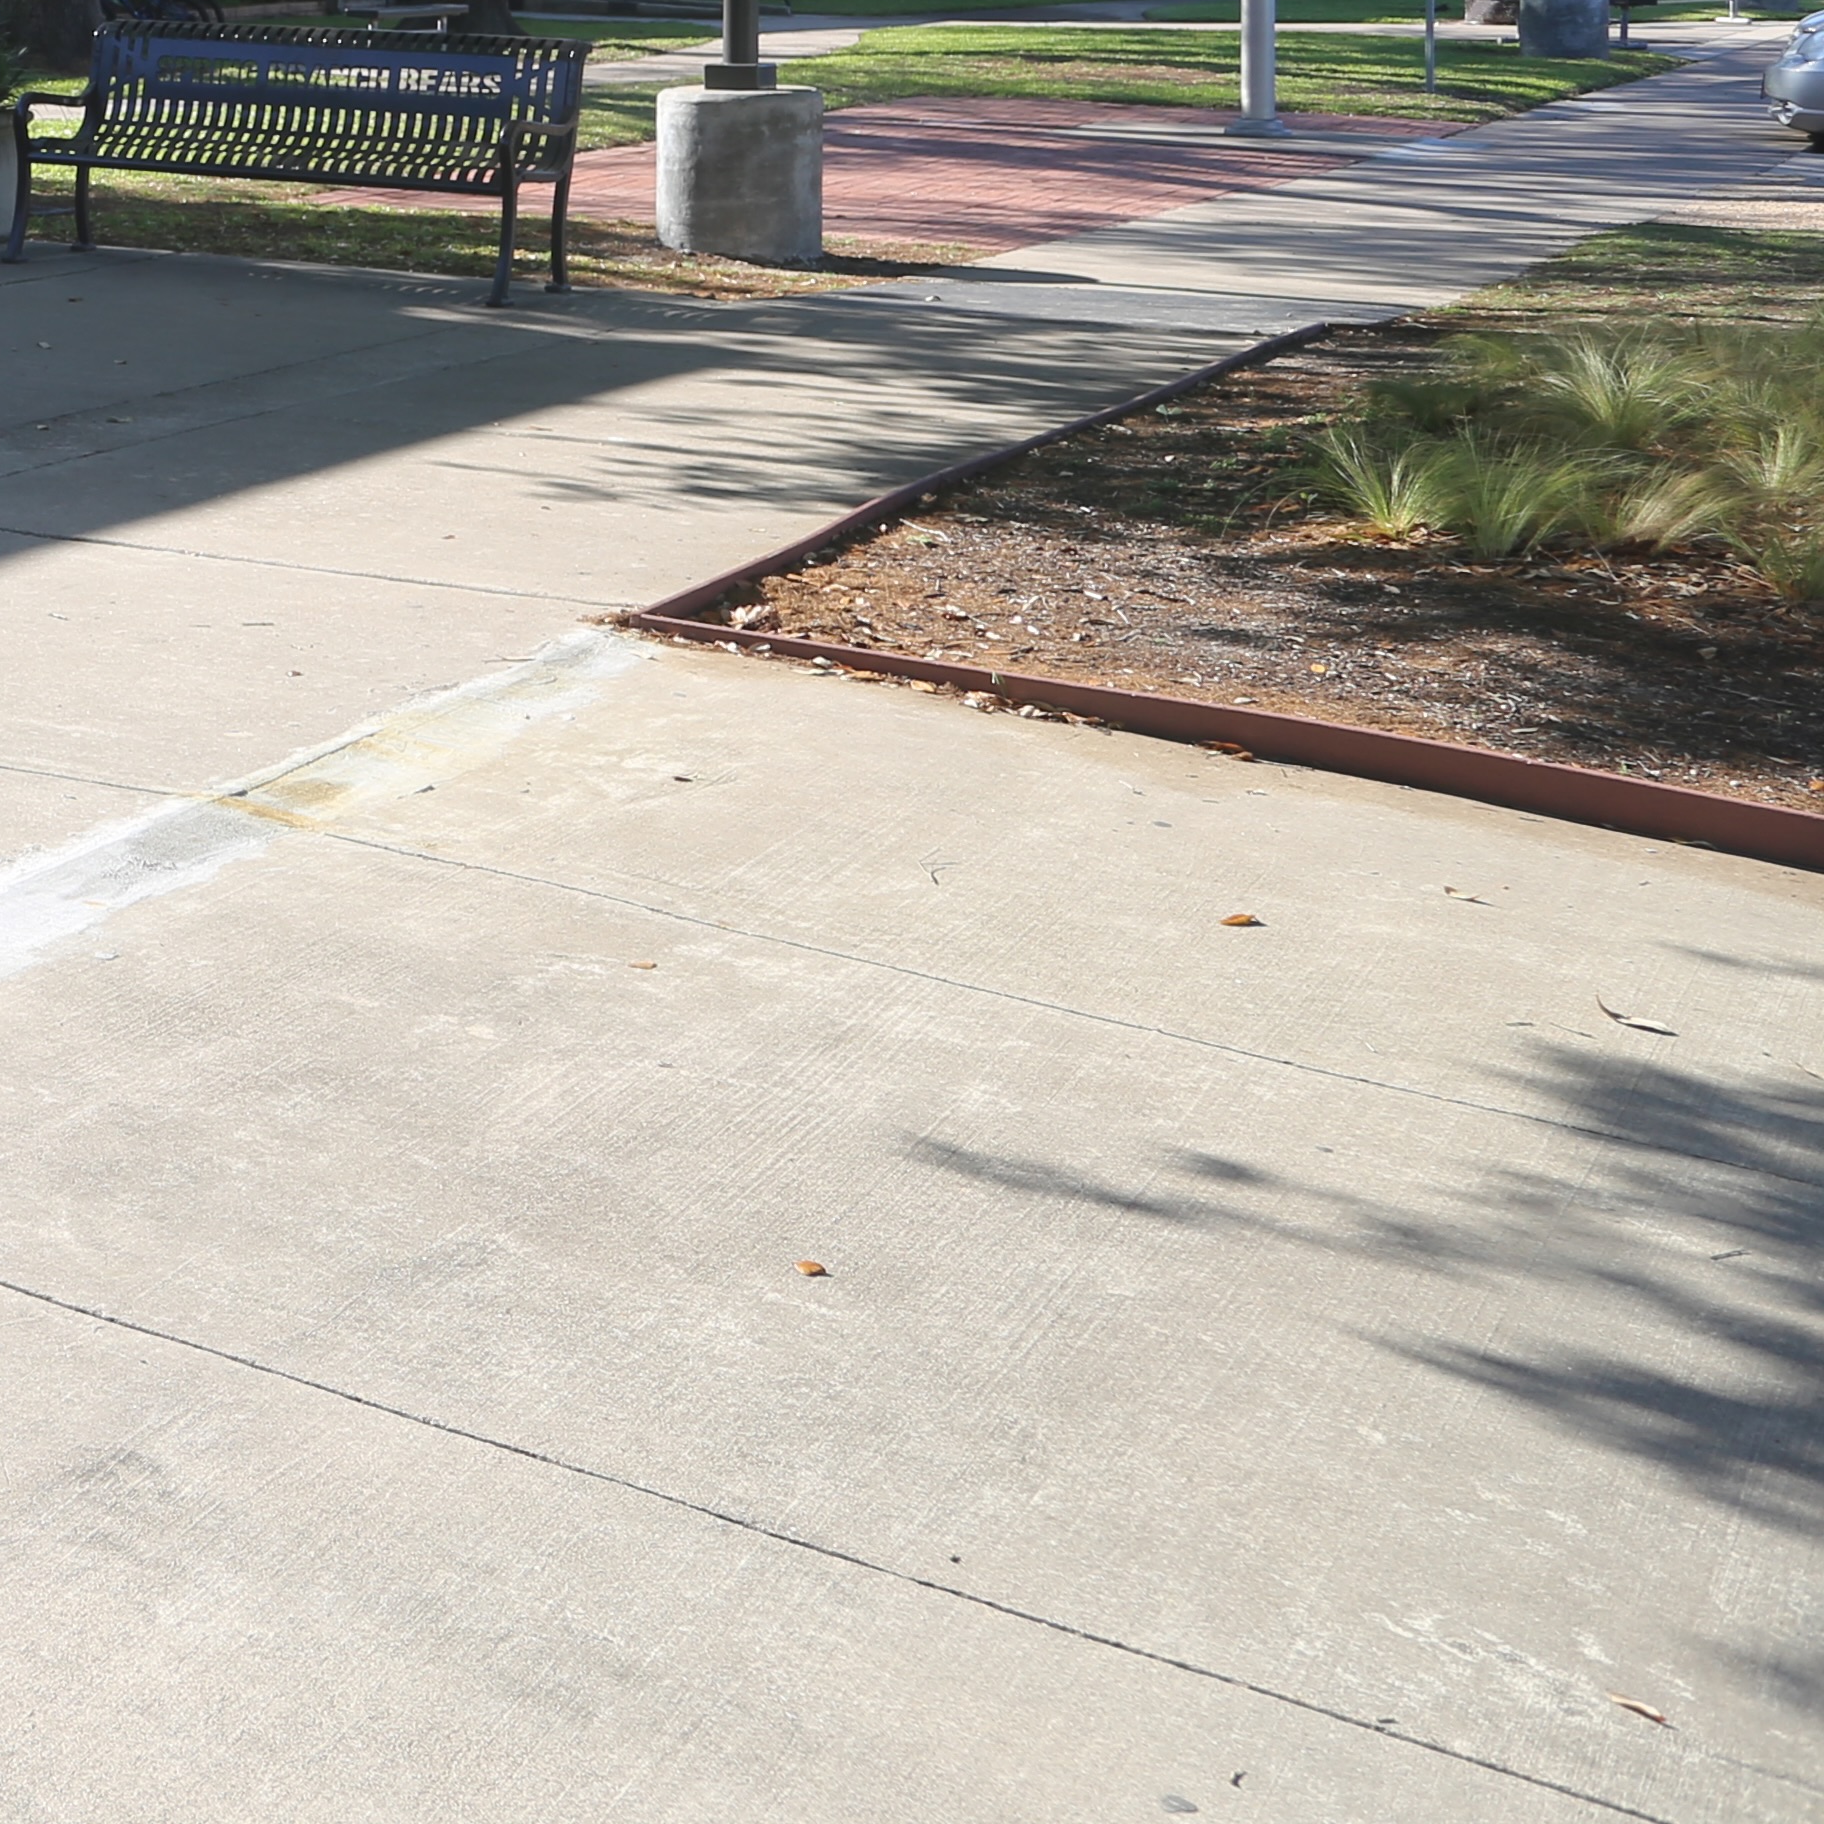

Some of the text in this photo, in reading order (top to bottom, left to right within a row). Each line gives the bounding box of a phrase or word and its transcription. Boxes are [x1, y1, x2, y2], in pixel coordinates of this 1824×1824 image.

[156, 55, 503, 98] SPRING BRANCH BEARS
